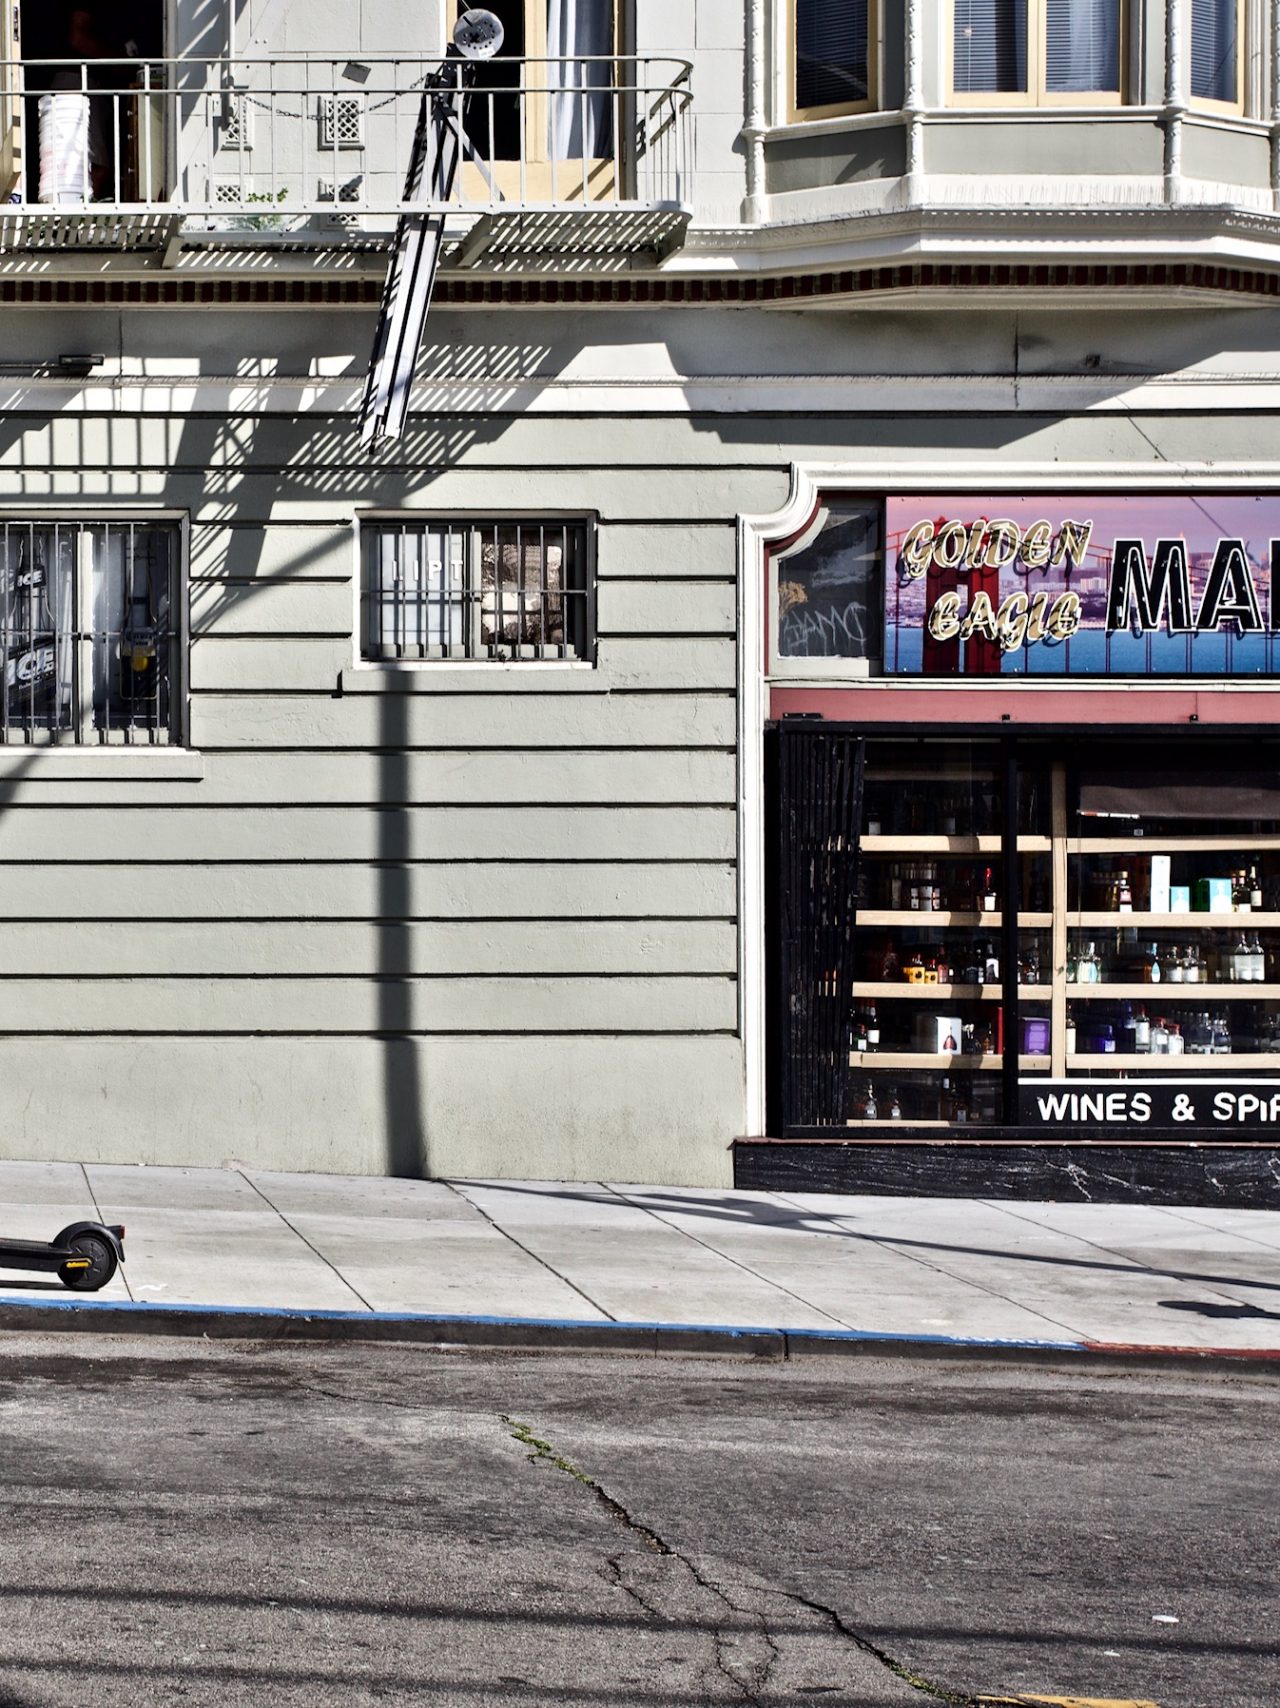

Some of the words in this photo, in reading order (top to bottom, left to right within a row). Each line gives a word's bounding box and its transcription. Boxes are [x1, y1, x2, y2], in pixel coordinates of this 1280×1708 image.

[6, 648, 55, 687] ICE
[1037, 1092, 1152, 1121] WINES
[1171, 1093, 1196, 1121] &
